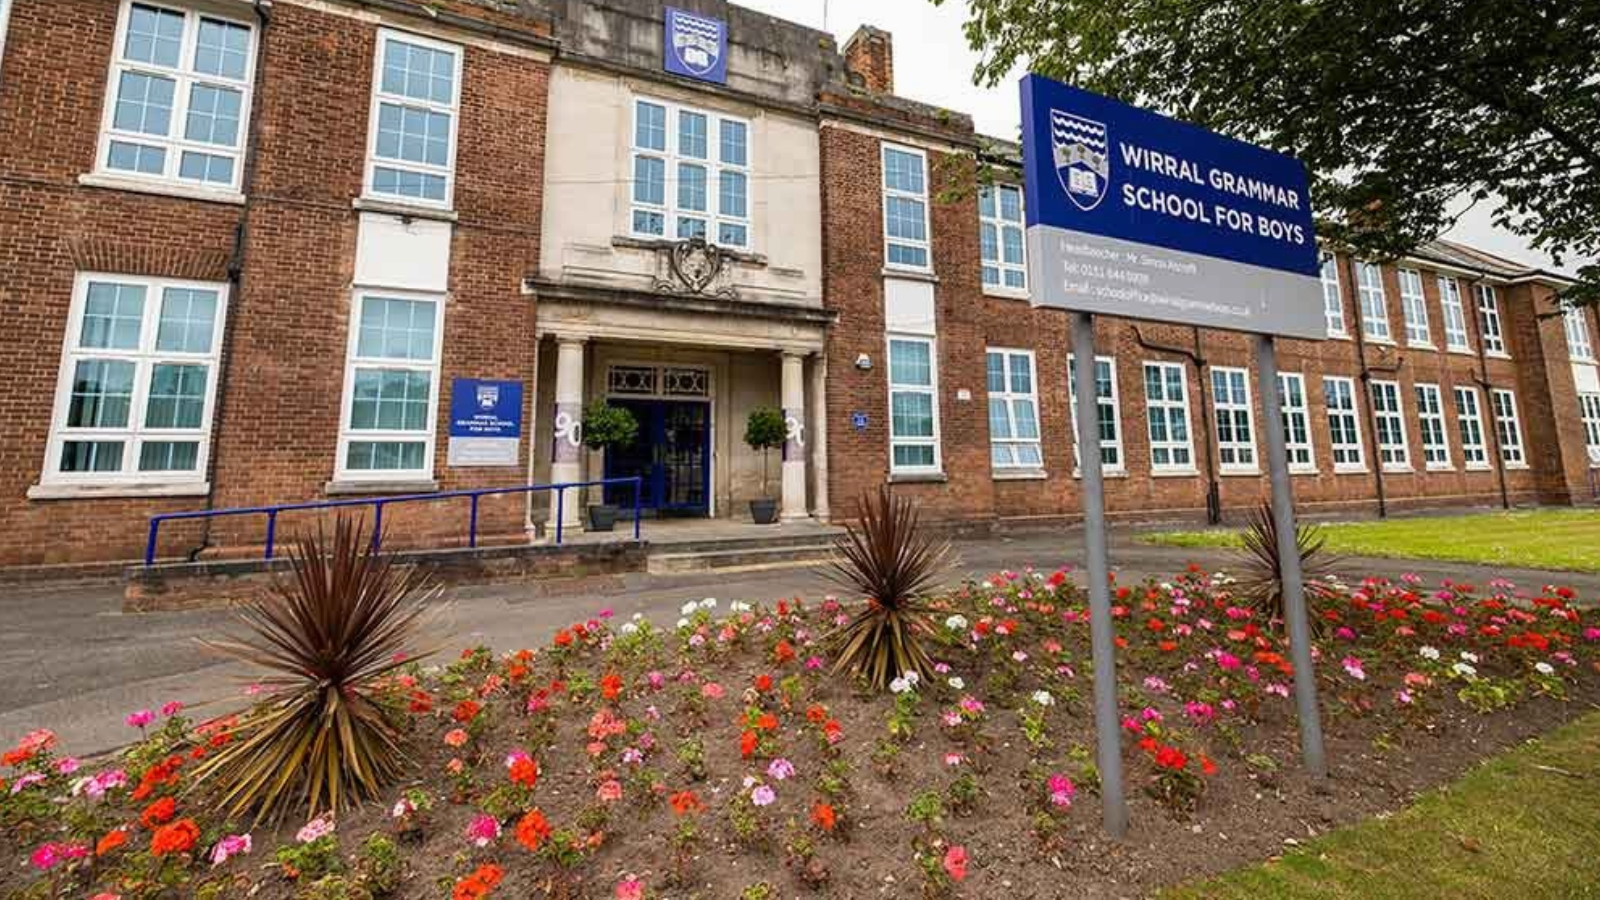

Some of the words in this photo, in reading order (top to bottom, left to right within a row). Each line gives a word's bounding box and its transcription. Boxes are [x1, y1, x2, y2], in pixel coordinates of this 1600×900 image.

[1119, 142, 1205, 185] WIRRAL
[1209, 168, 1300, 210] GRAMMAR
[1122, 183, 1211, 224] SCHOOL
[1215, 205, 1254, 234] FOR
[1257, 216, 1305, 245] BOYS
[554, 411, 582, 447] 90
